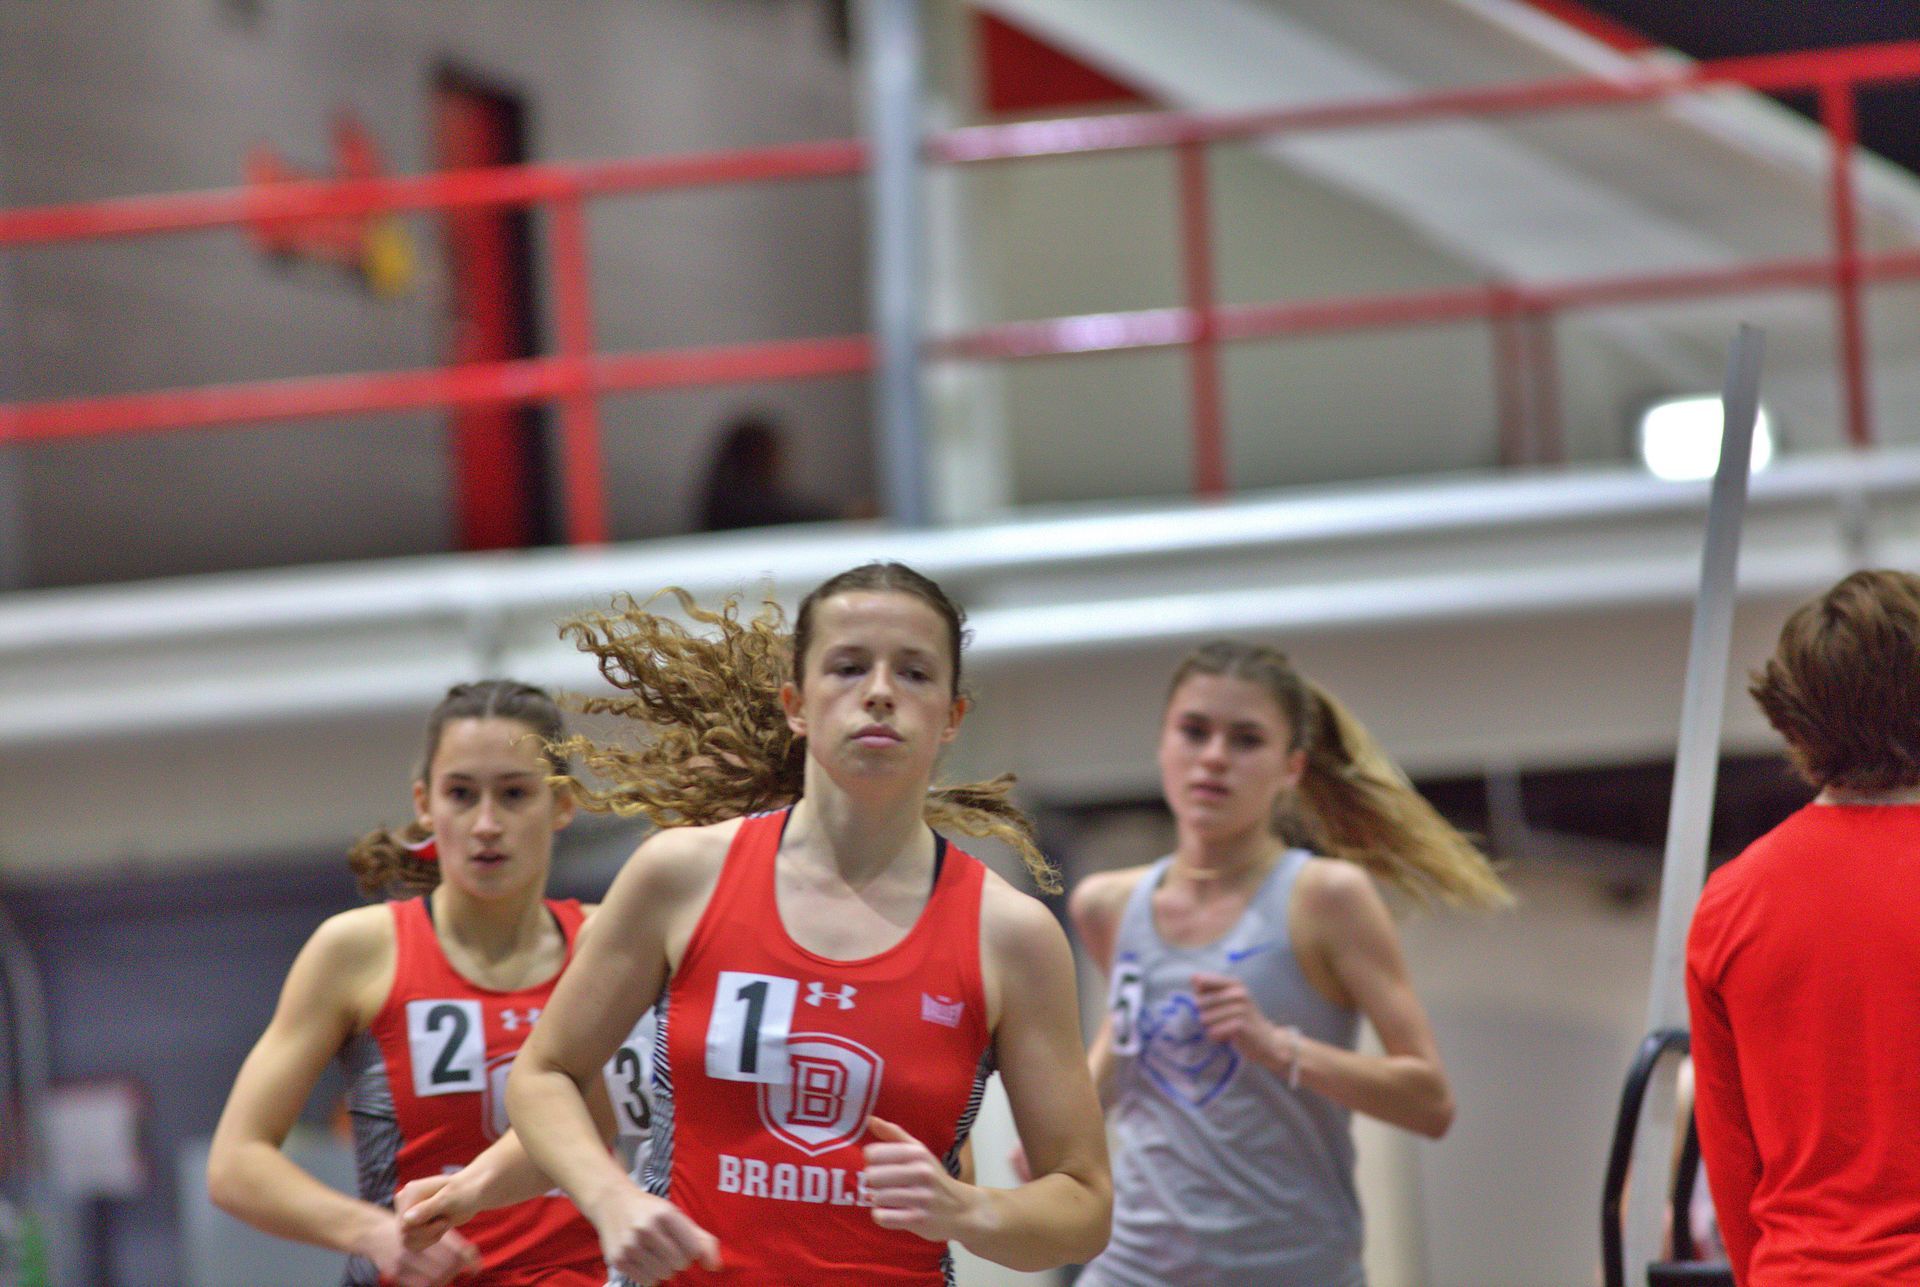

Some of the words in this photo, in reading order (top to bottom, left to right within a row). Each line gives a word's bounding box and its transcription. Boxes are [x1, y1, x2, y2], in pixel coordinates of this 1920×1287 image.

[425, 1003, 471, 1085] 2
[735, 980, 769, 1074] 1
[615, 1046, 651, 1129] 3
[786, 1053, 848, 1129] B
